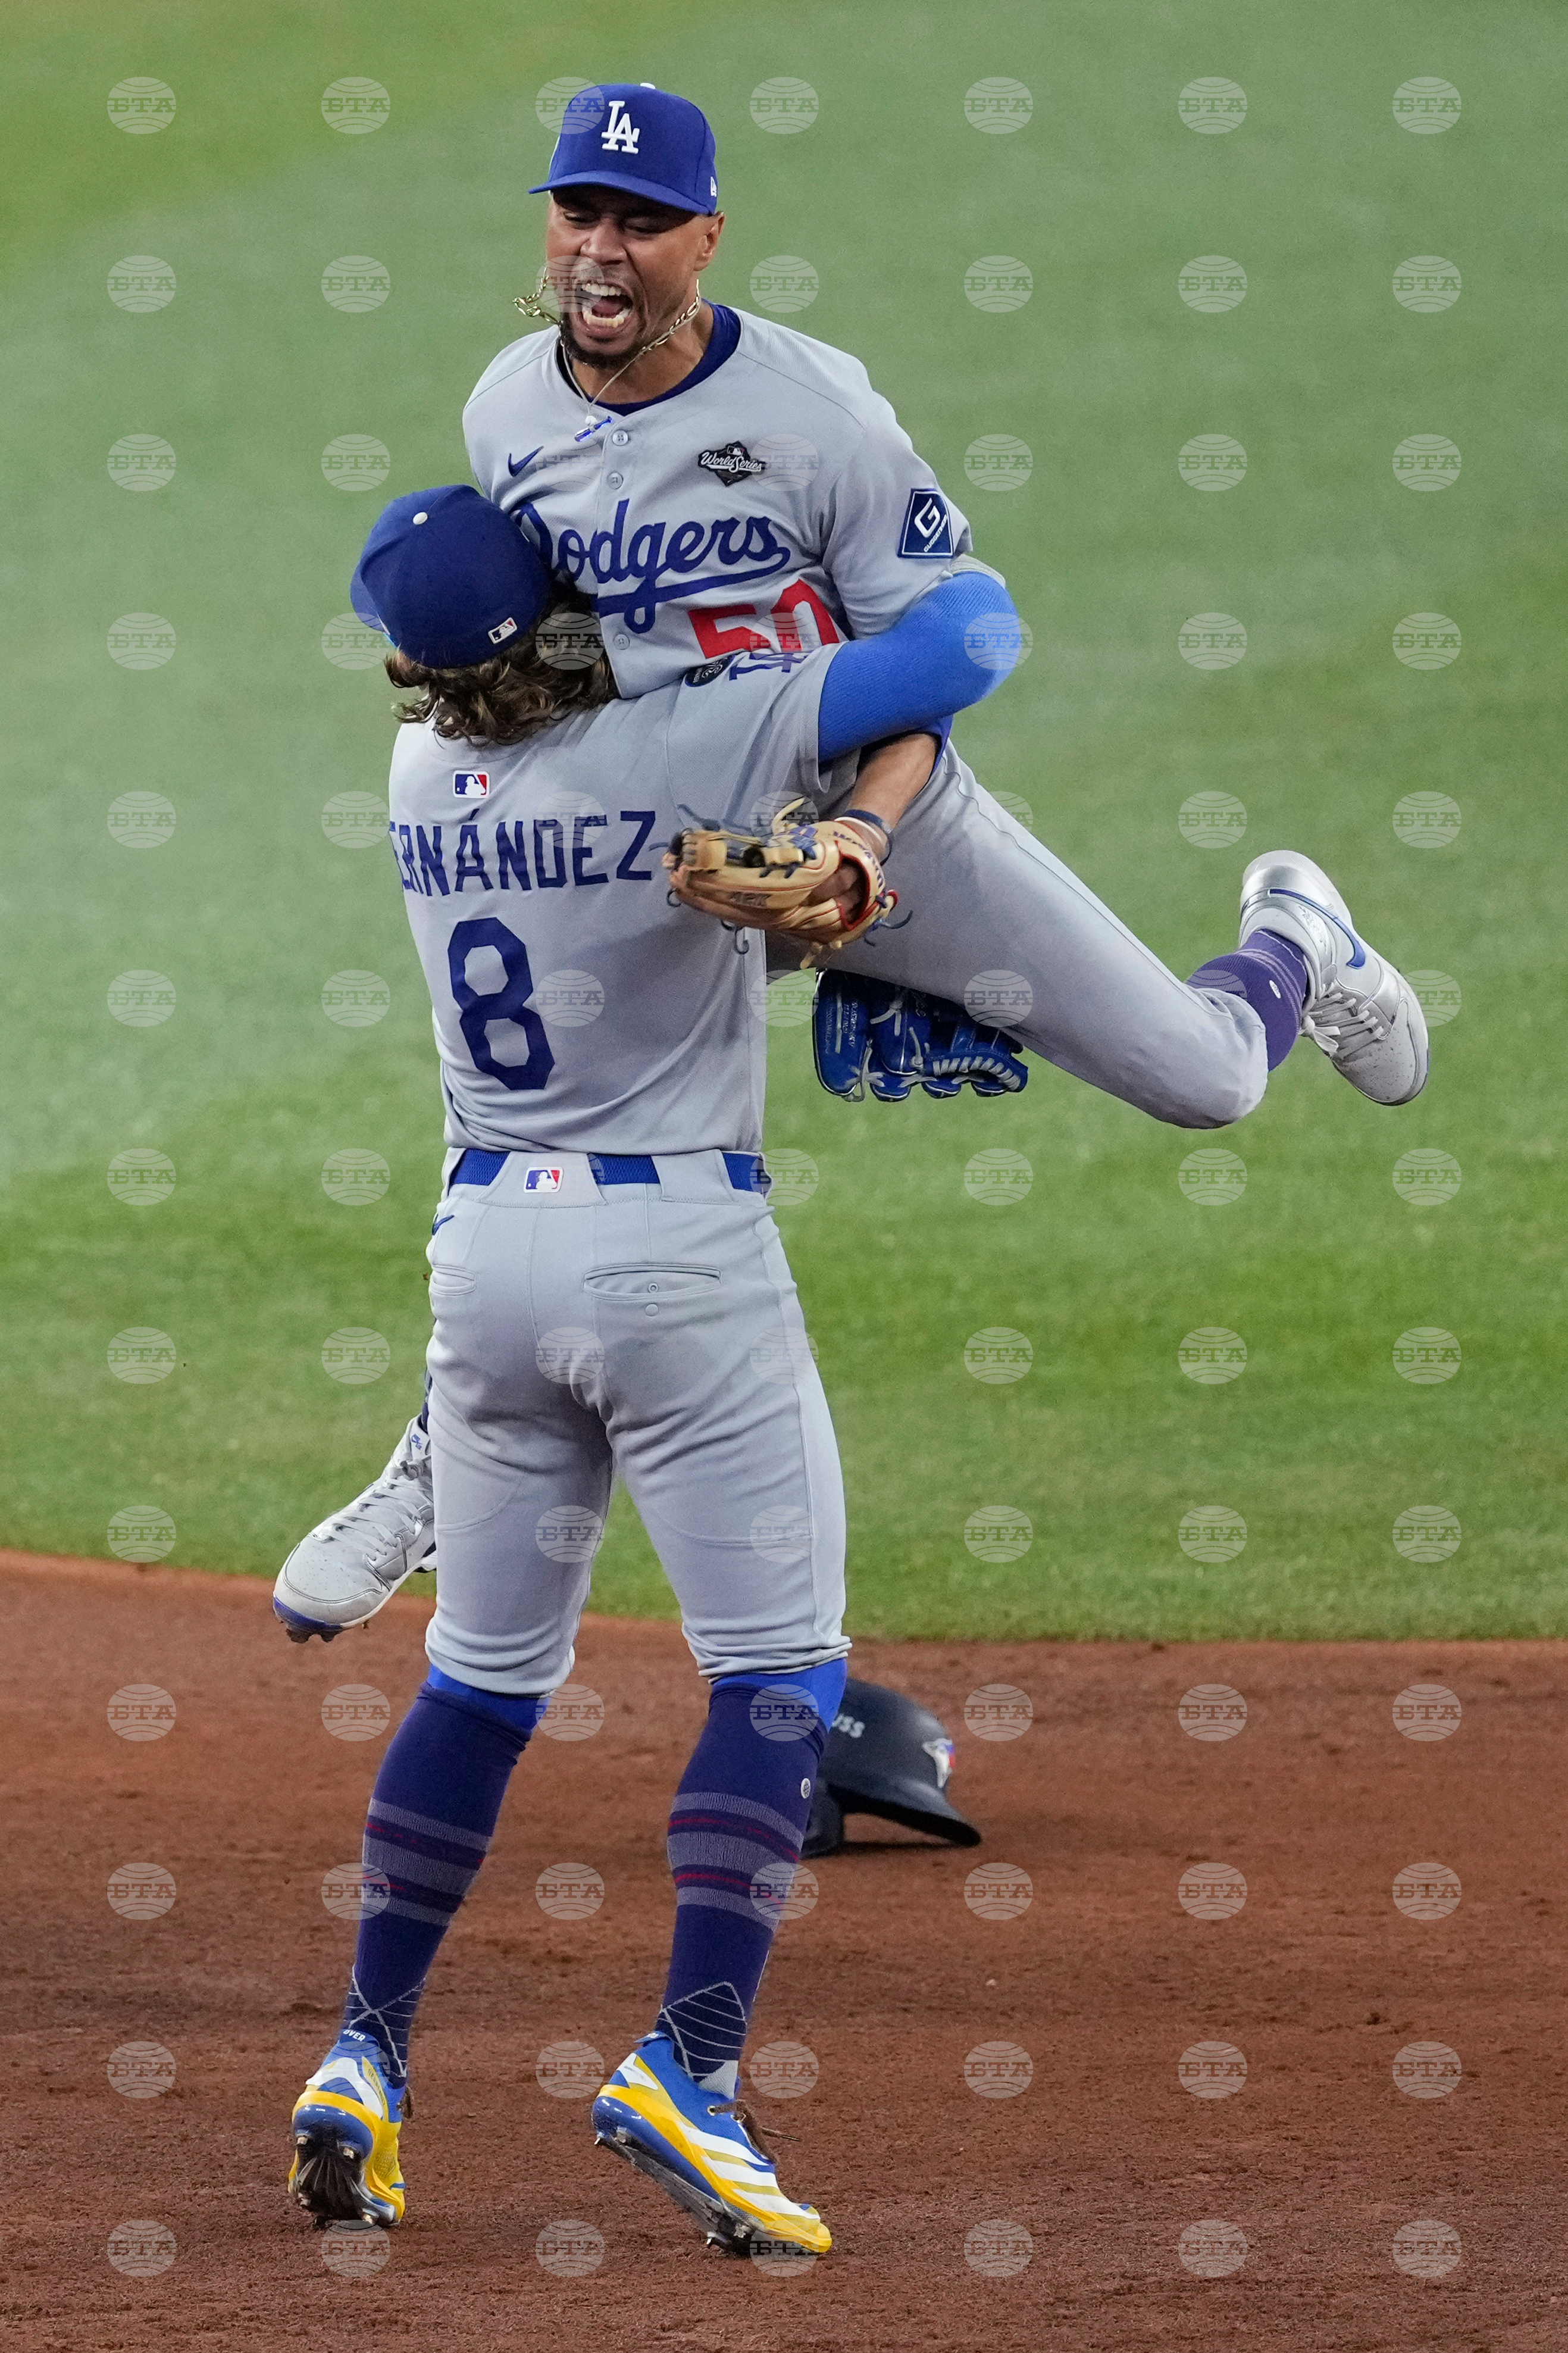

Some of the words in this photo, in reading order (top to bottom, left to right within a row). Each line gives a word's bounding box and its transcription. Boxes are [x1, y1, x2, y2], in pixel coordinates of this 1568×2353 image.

[601, 100, 640, 154] LA
[700, 452, 737, 467] World
[728, 455, 762, 473] Series
[513, 498, 790, 633] Dodgers
[447, 917, 555, 1090] 8
